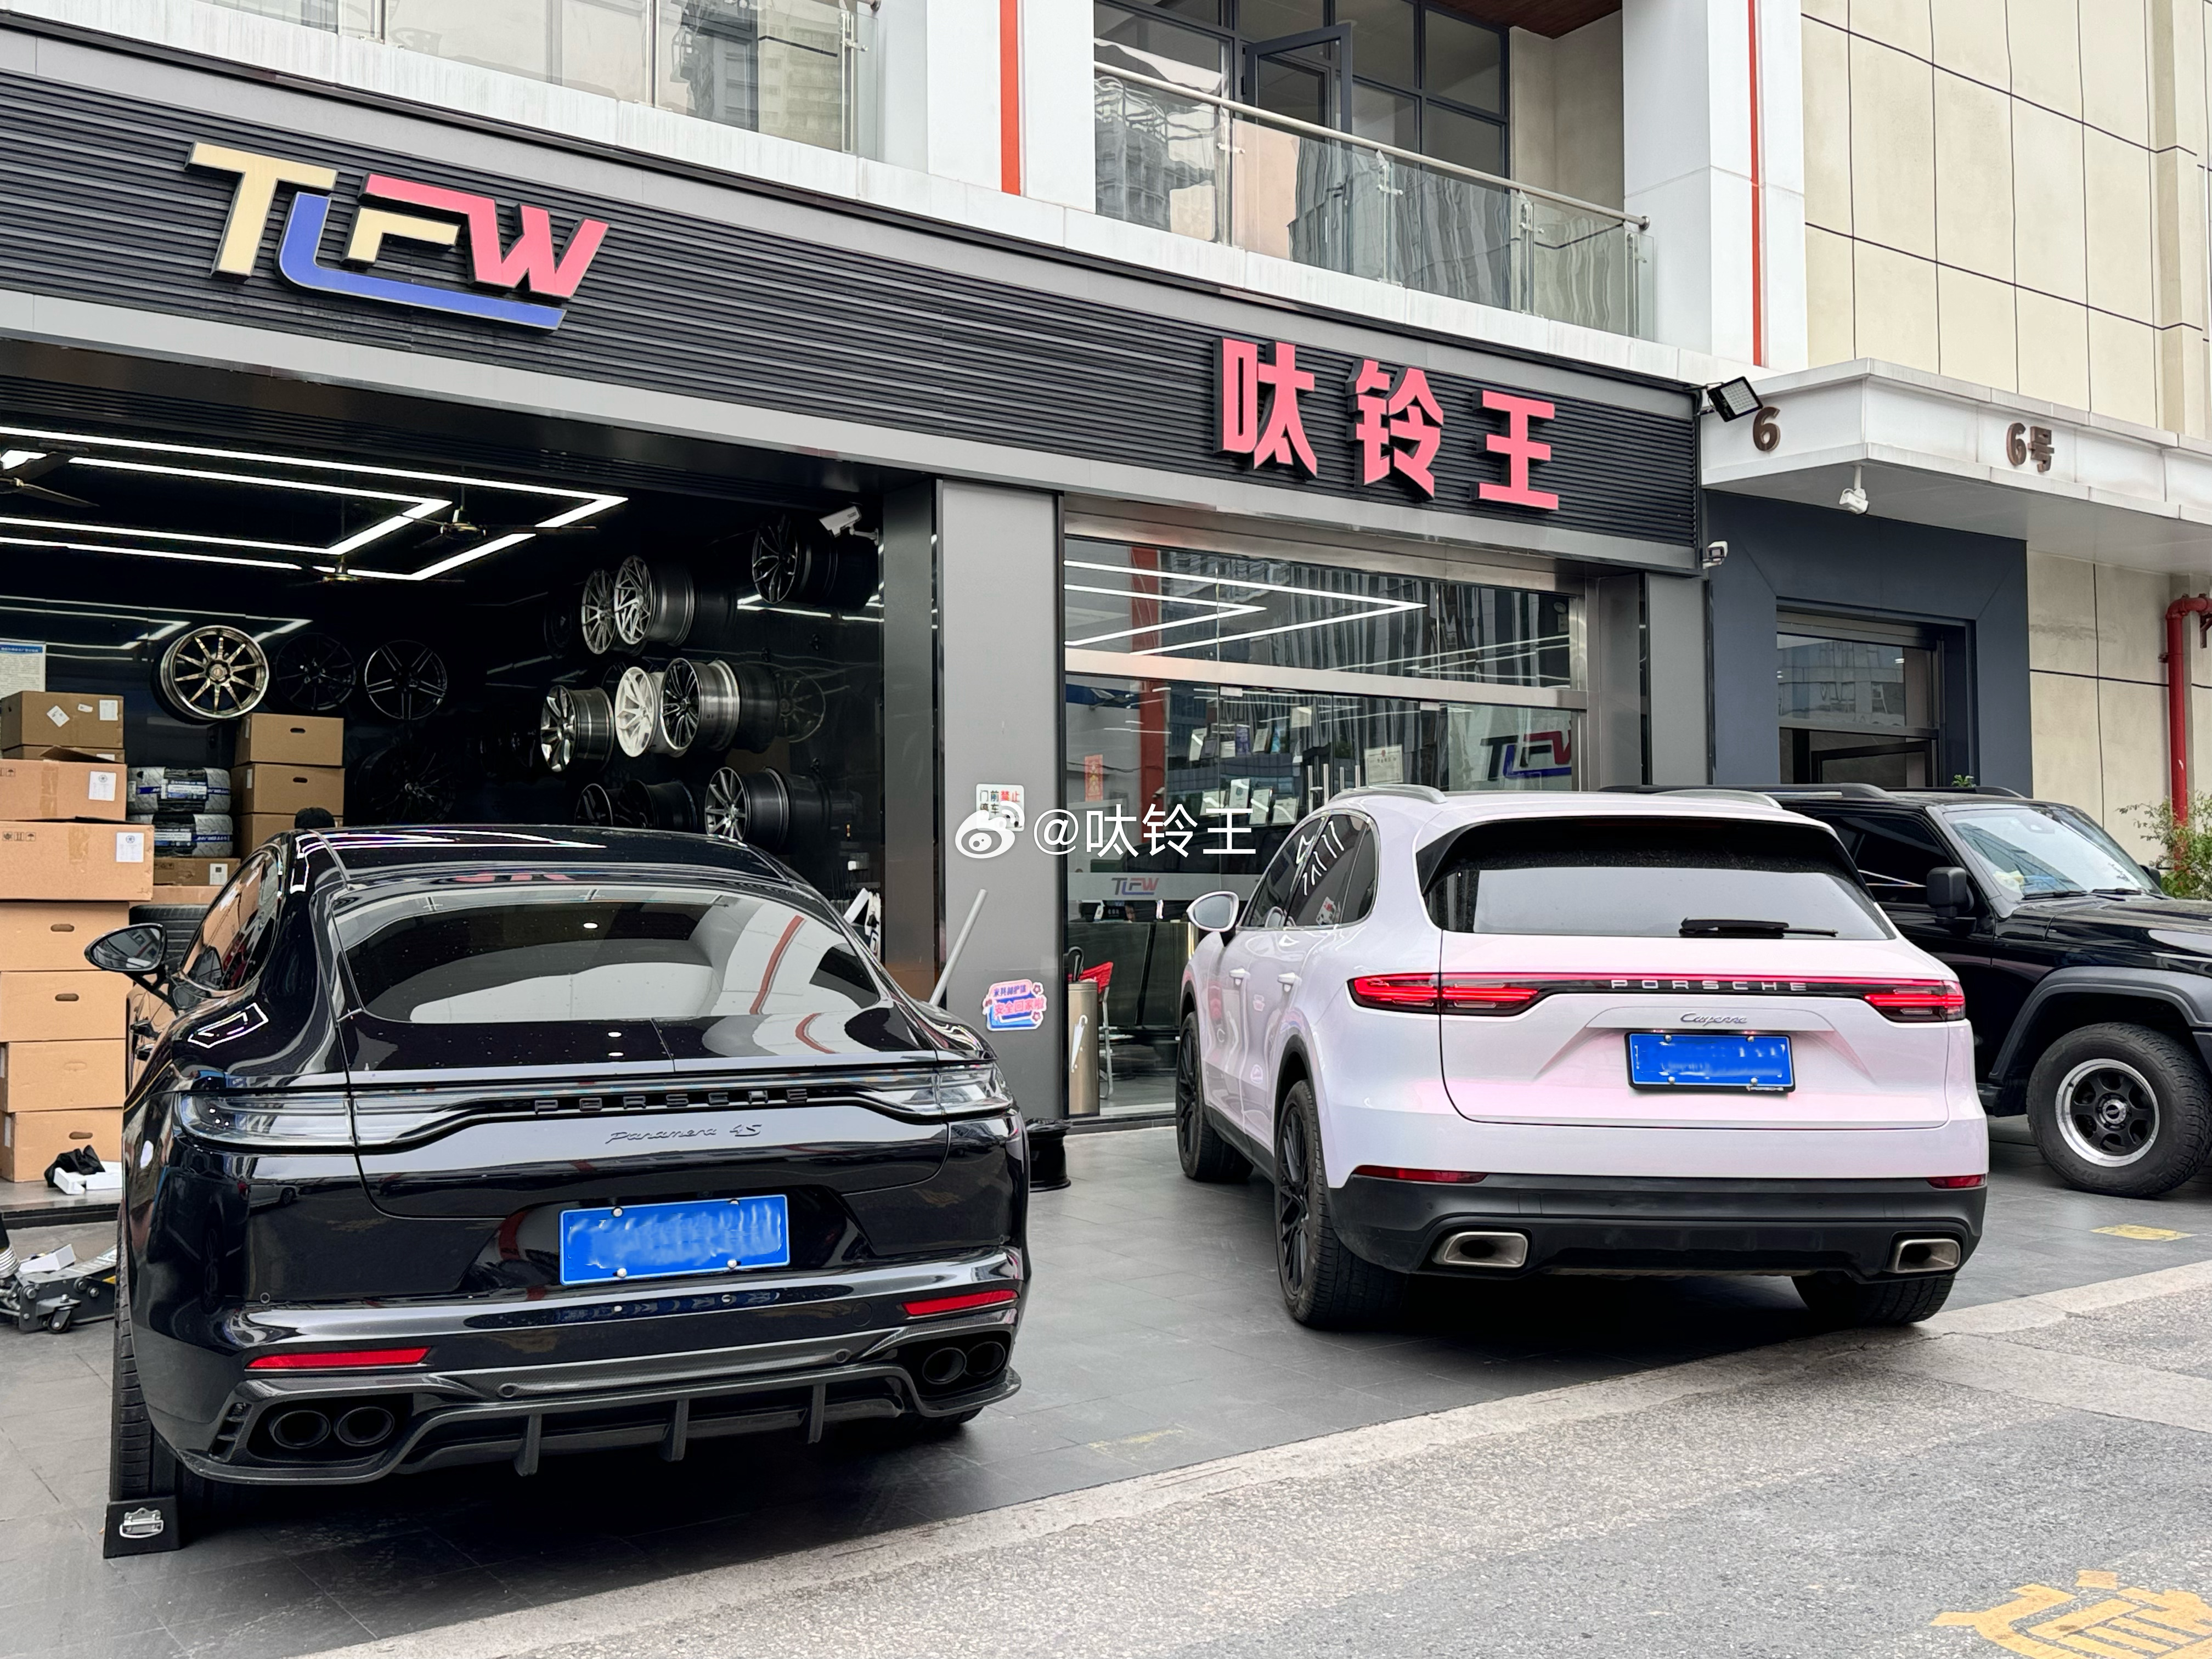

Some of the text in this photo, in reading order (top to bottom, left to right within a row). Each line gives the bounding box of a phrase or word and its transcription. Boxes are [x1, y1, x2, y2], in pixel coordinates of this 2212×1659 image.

[1215, 338, 1559, 510] 呔铃王
[1753, 407, 1780, 452] 6
[2006, 422, 2055, 472] 6号
[1611, 979, 1807, 991] PORSCHE
[1680, 1012, 1747, 1026] Cayenne
[535, 1089, 808, 1115] PORSCHE
[605, 1128, 717, 1144] Panamera
